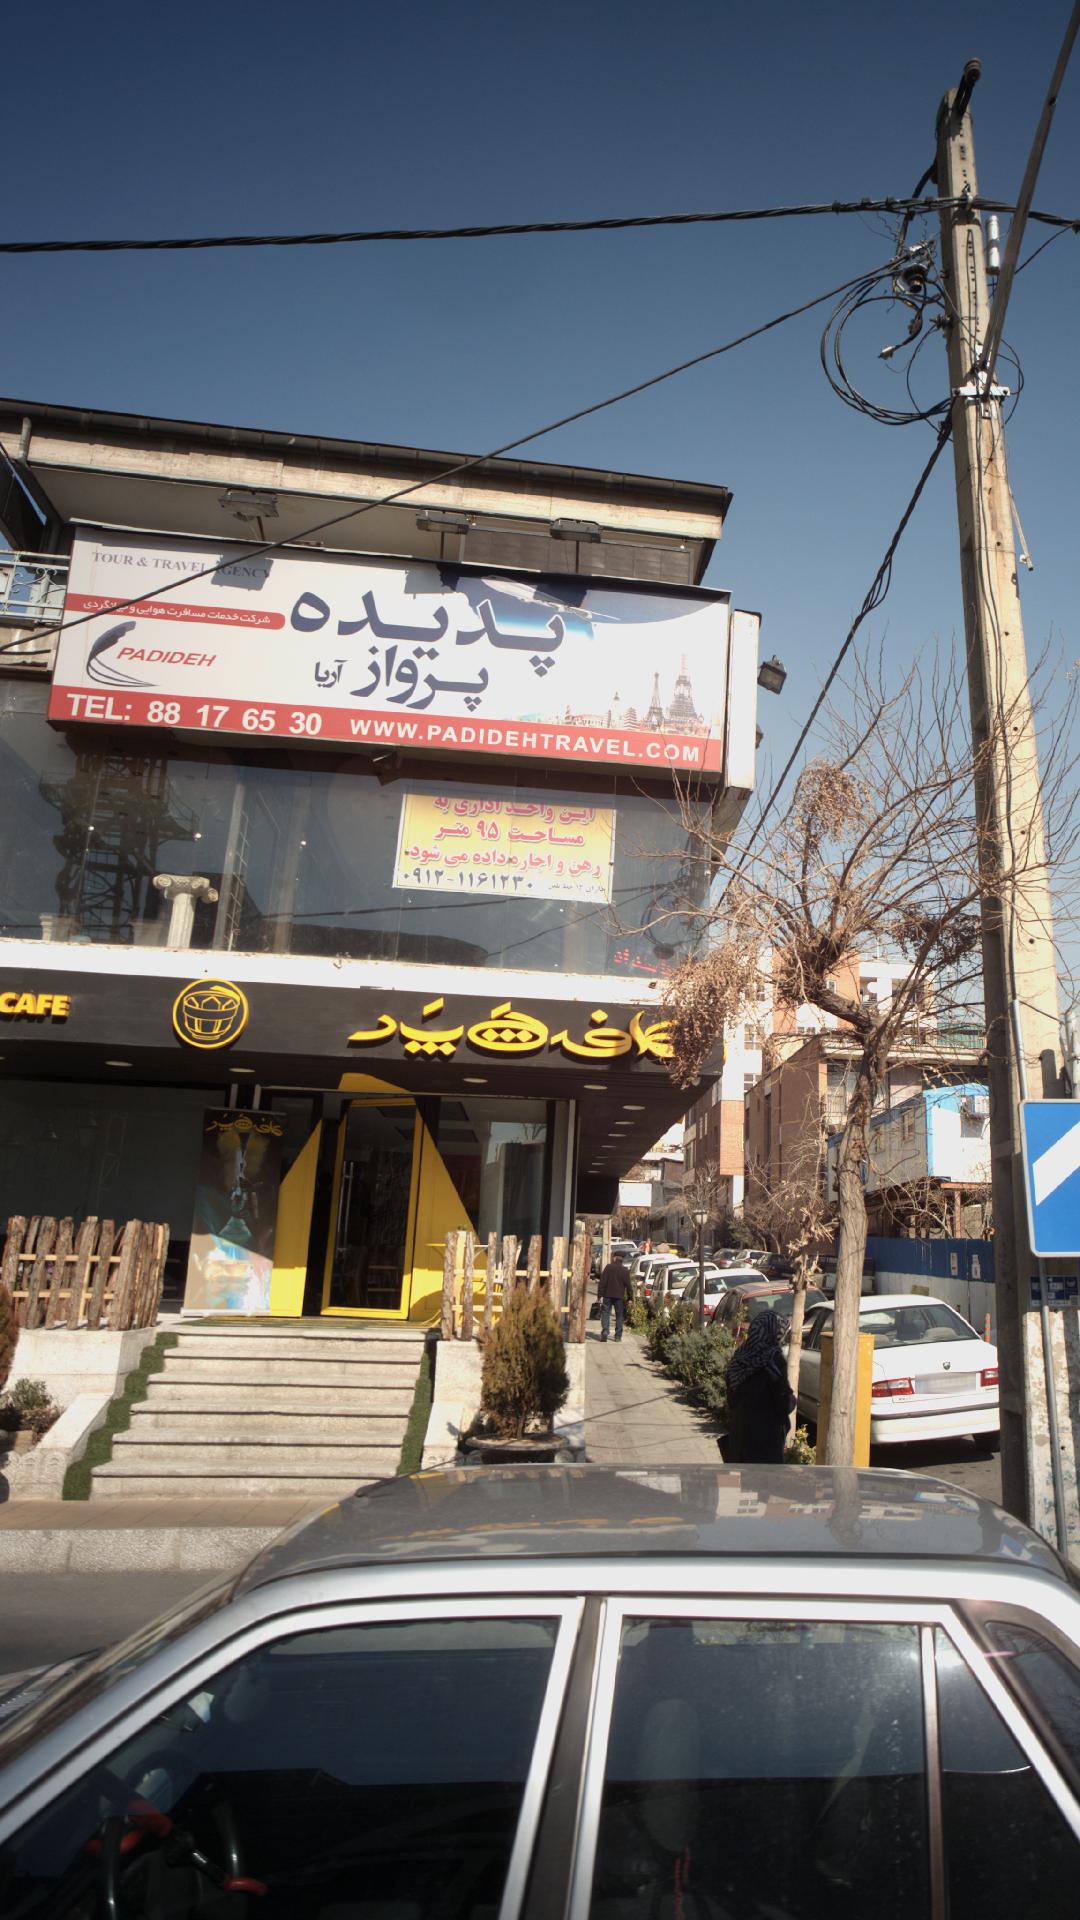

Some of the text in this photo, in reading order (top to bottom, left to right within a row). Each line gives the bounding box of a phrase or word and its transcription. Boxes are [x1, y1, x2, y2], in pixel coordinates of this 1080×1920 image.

[92, 551, 134, 567] TOUR
[135, 556, 149, 568] &
[150, 558, 207, 576] TRAVEL
[167, 607, 206, 619] مسافرت
[207, 611, 239, 622] خدمات
[240, 614, 271, 626] شرکت
[291, 589, 565, 677] پدیده
[116, 647, 217, 668] PADIDEH
[314, 645, 489, 712] پرواز آریا
[66, 693, 700, 763] TEL: 88 17 65 30 WWW.PADIDEHTRAVEL.COM
[560, 804, 593, 824] این
[435, 819, 584, 846] مساحت ۹۵ متر
[409, 845, 601, 877] رهن و اجاره داده می شود
[0, 992, 71, 1017] CAFE
